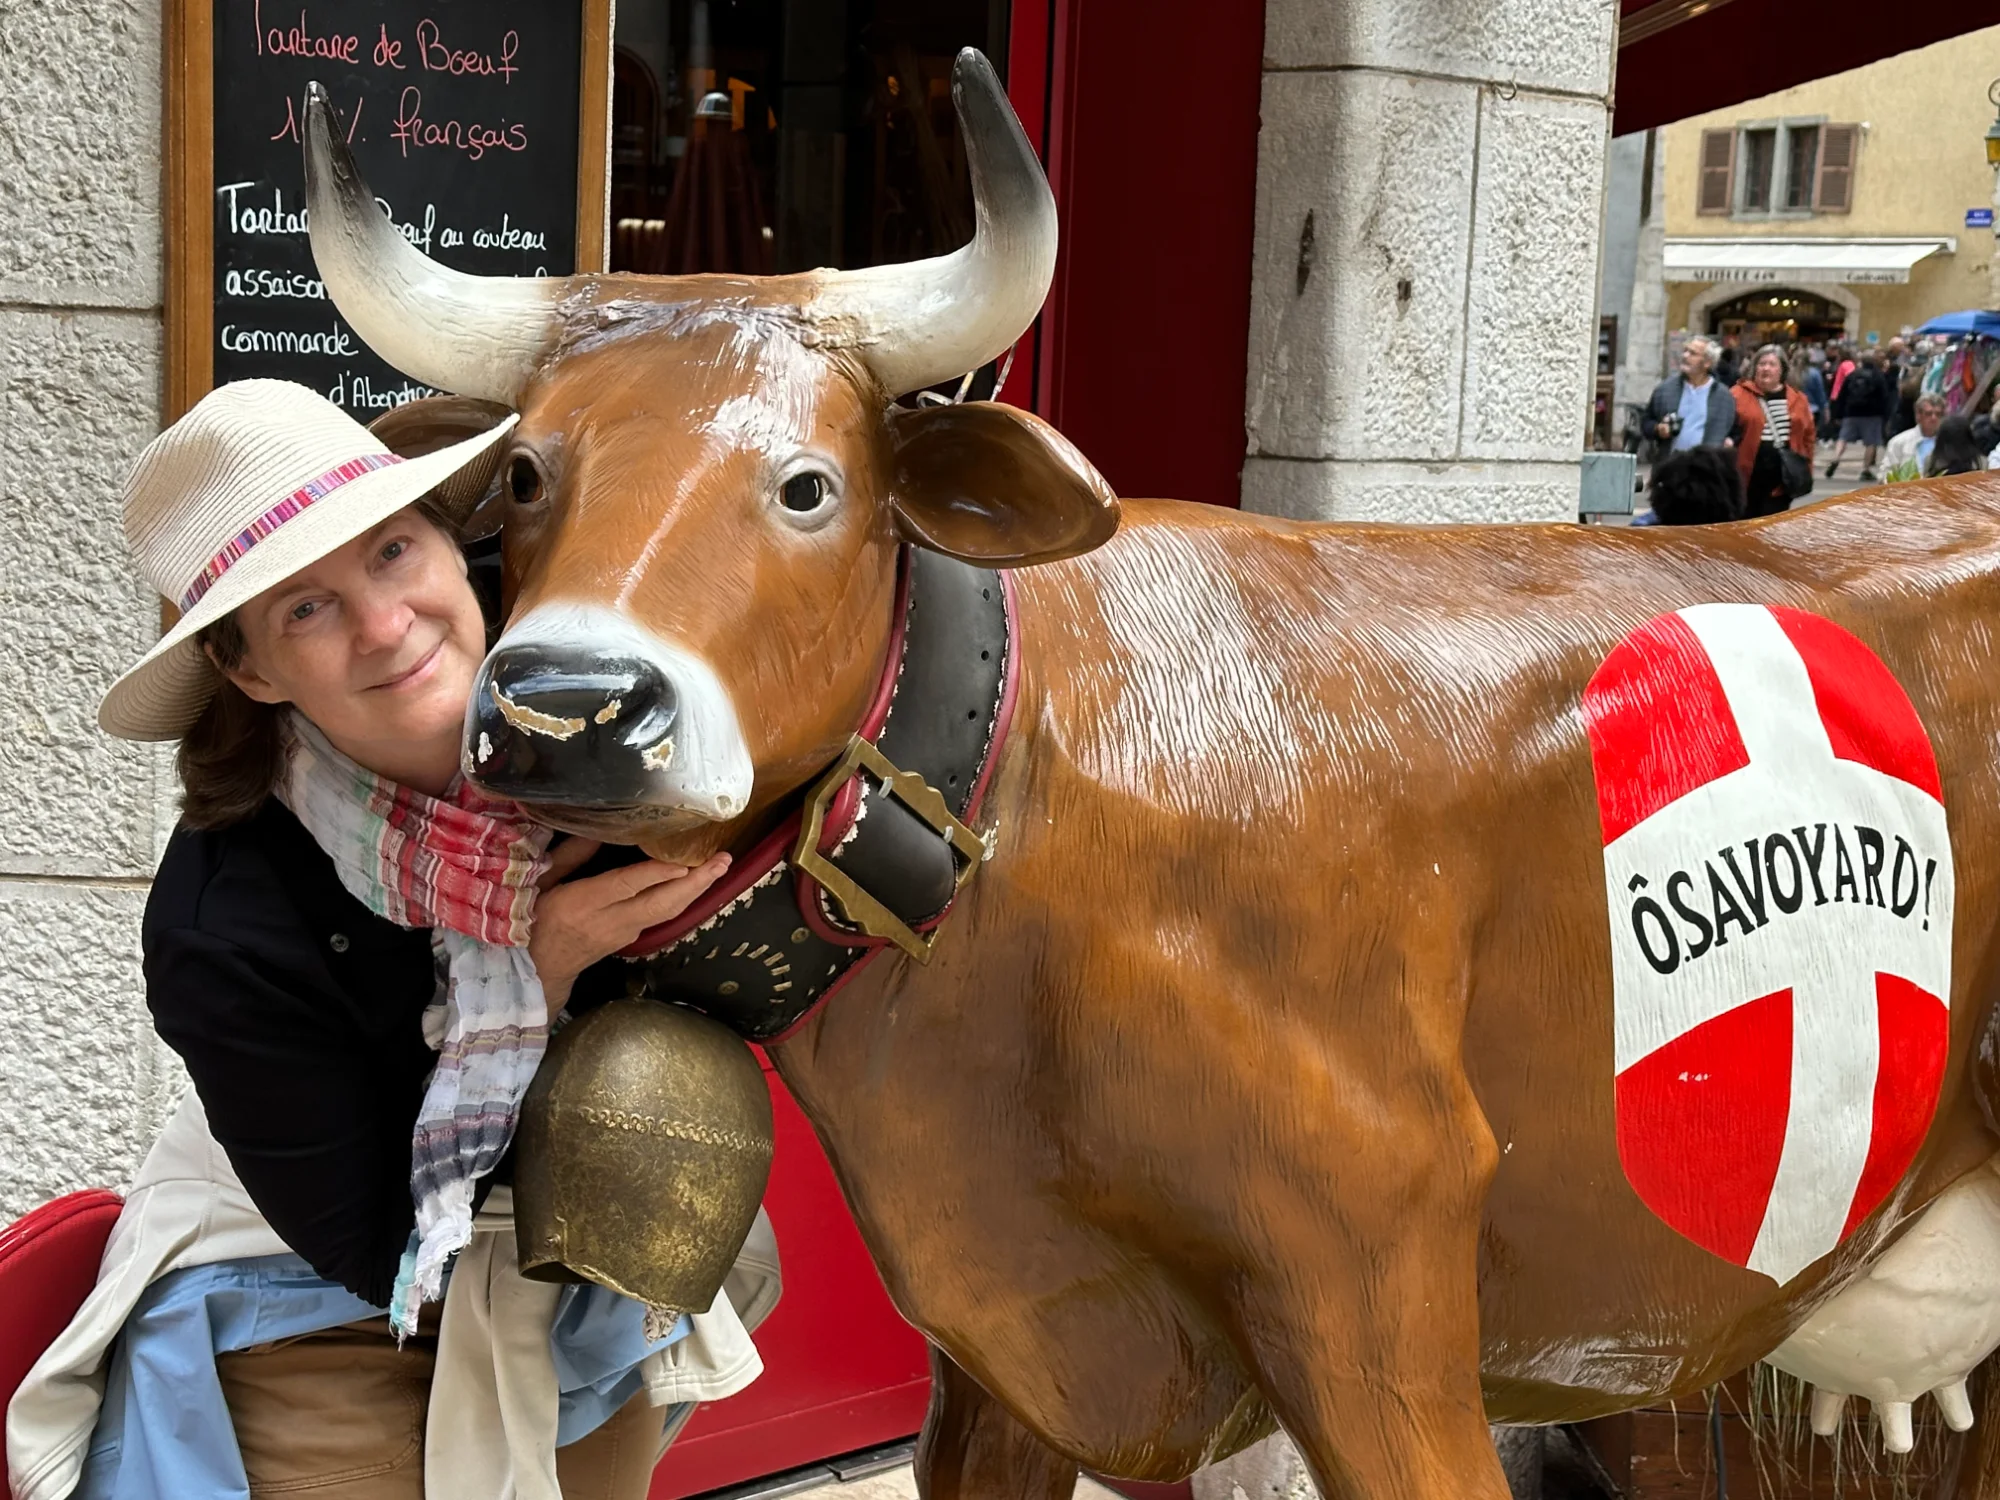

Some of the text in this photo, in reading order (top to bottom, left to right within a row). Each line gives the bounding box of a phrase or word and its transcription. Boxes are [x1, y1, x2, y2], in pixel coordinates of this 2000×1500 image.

[373, 23, 406, 70] de
[390, 86, 528, 161] français
[217, 181, 310, 234] Tartar
[440, 227, 465, 249] au
[472, 212, 547, 251] couteau
